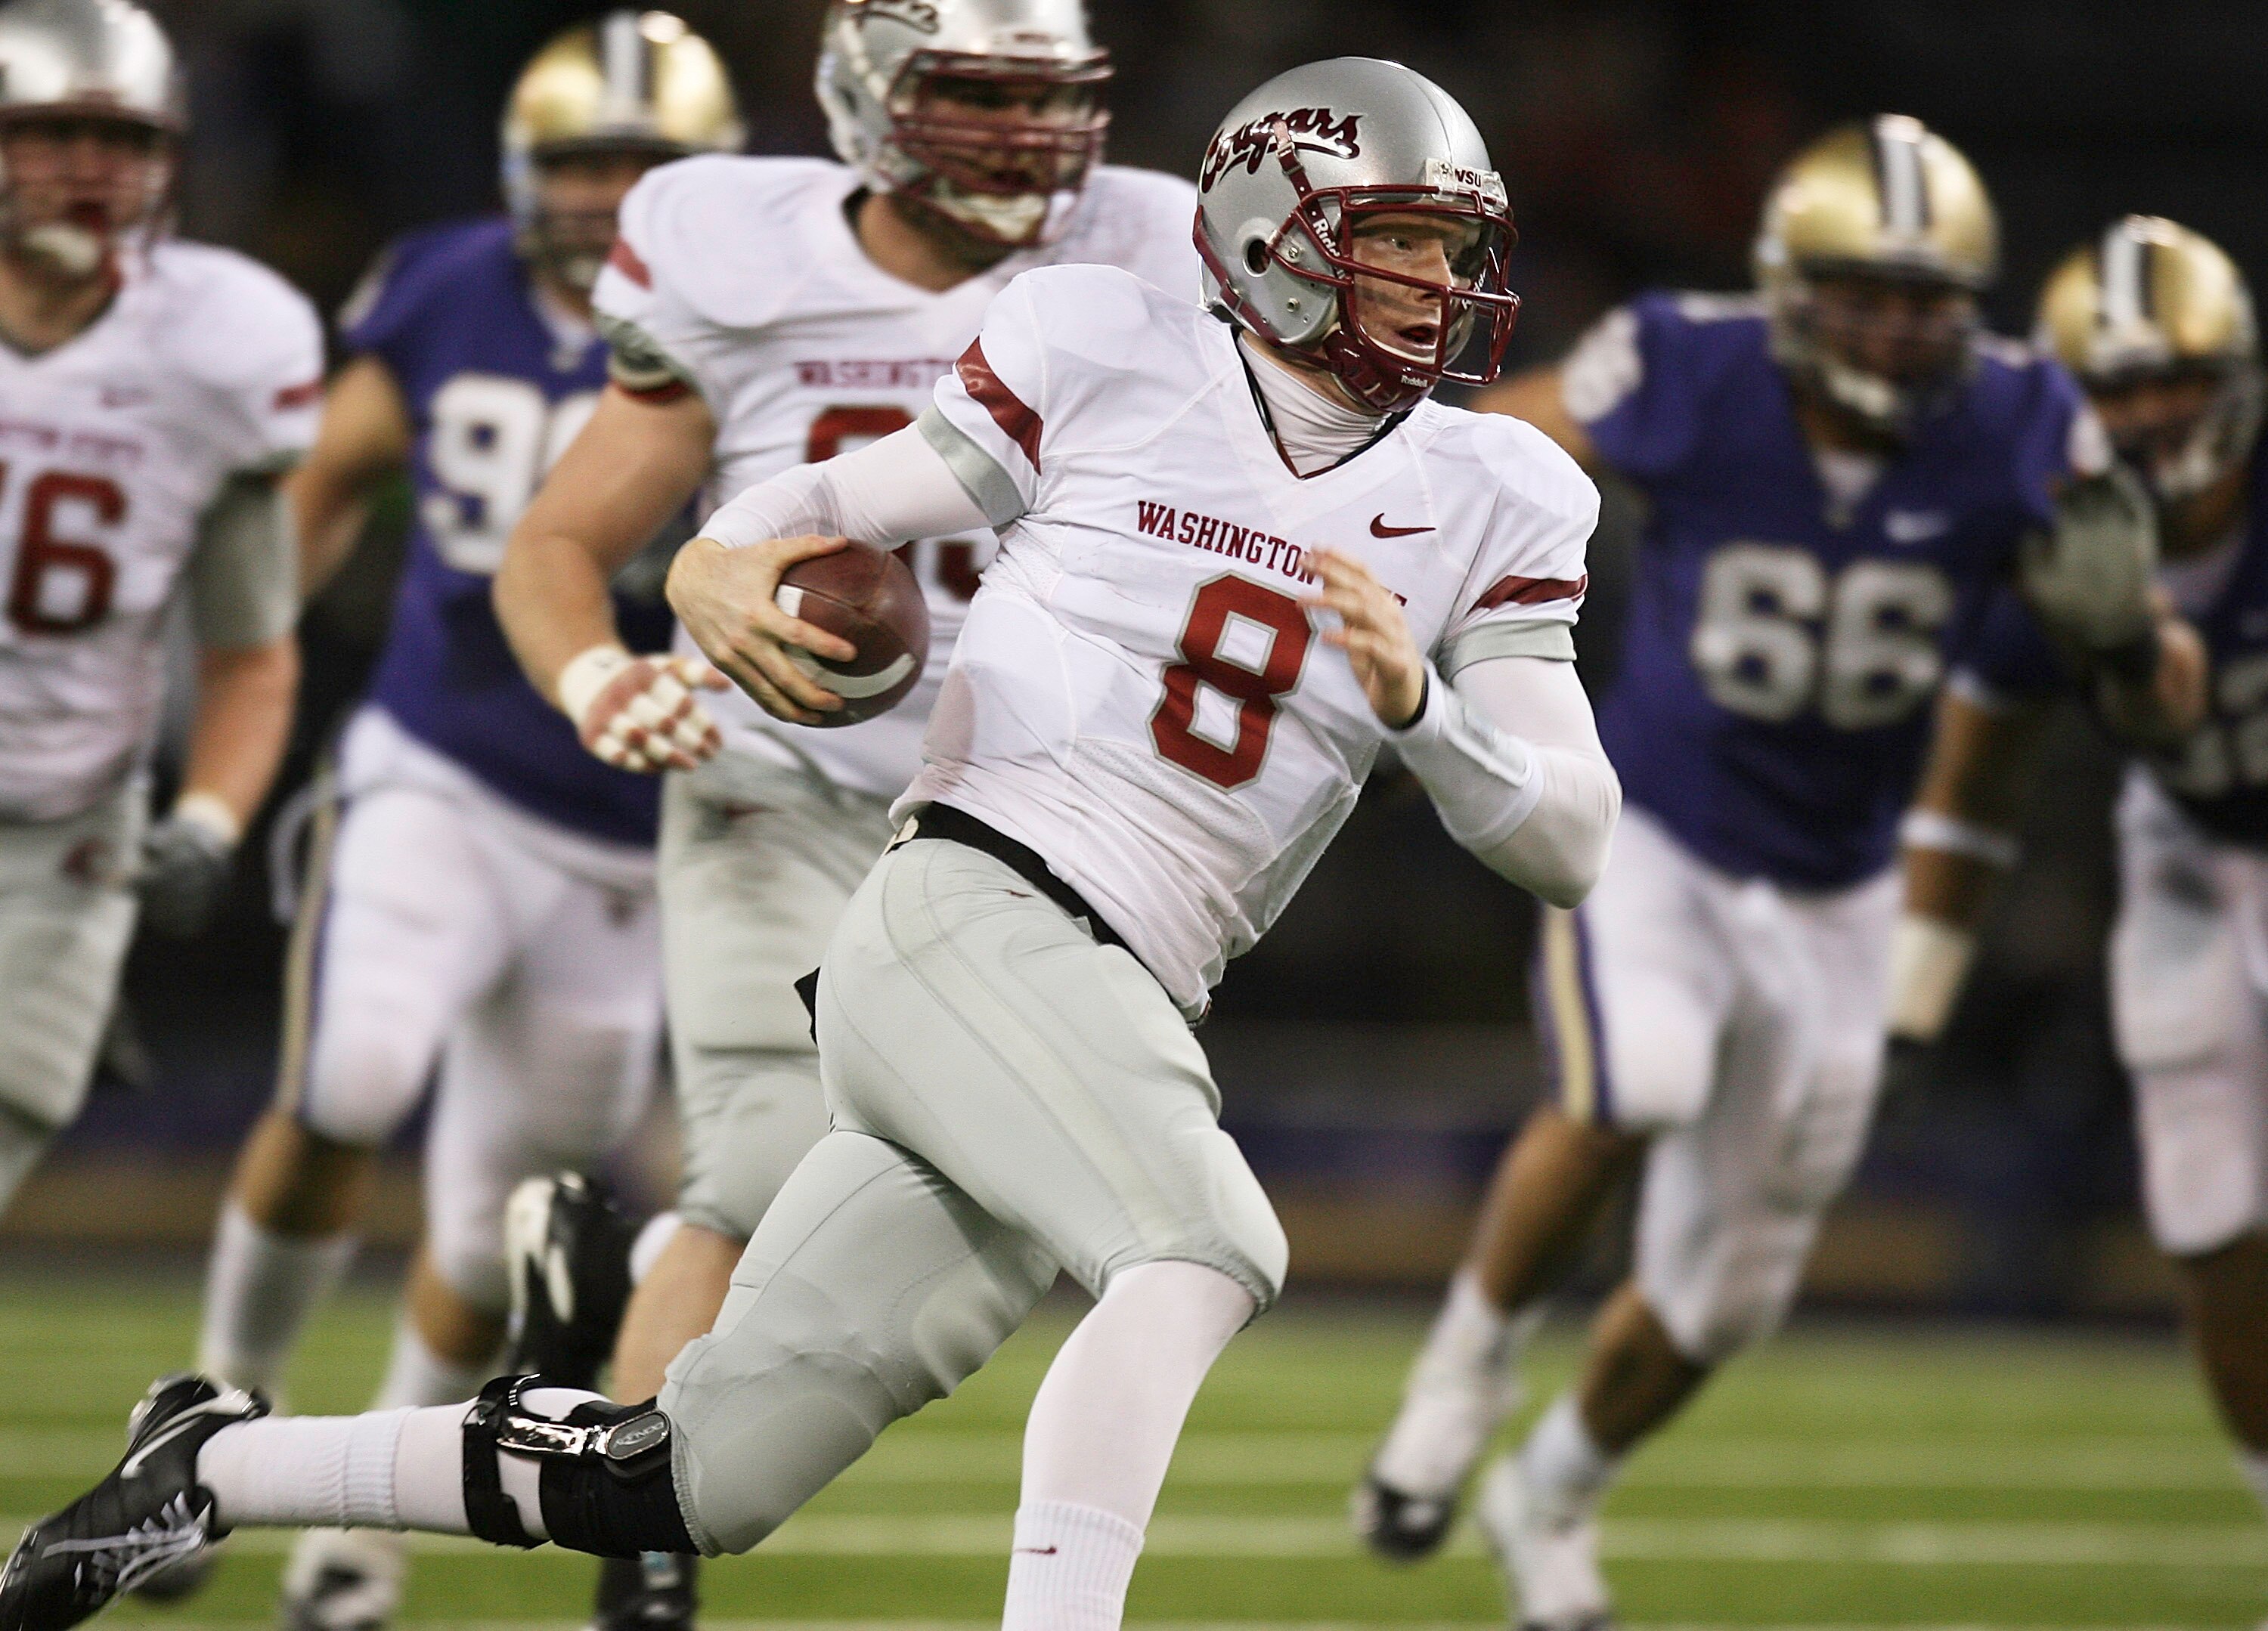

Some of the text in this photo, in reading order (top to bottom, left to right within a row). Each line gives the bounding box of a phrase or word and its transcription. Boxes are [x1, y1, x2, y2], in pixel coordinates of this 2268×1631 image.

[0, 461, 129, 636] 6
[1691, 540, 1954, 731] 66
[1145, 569, 1318, 795] 8
